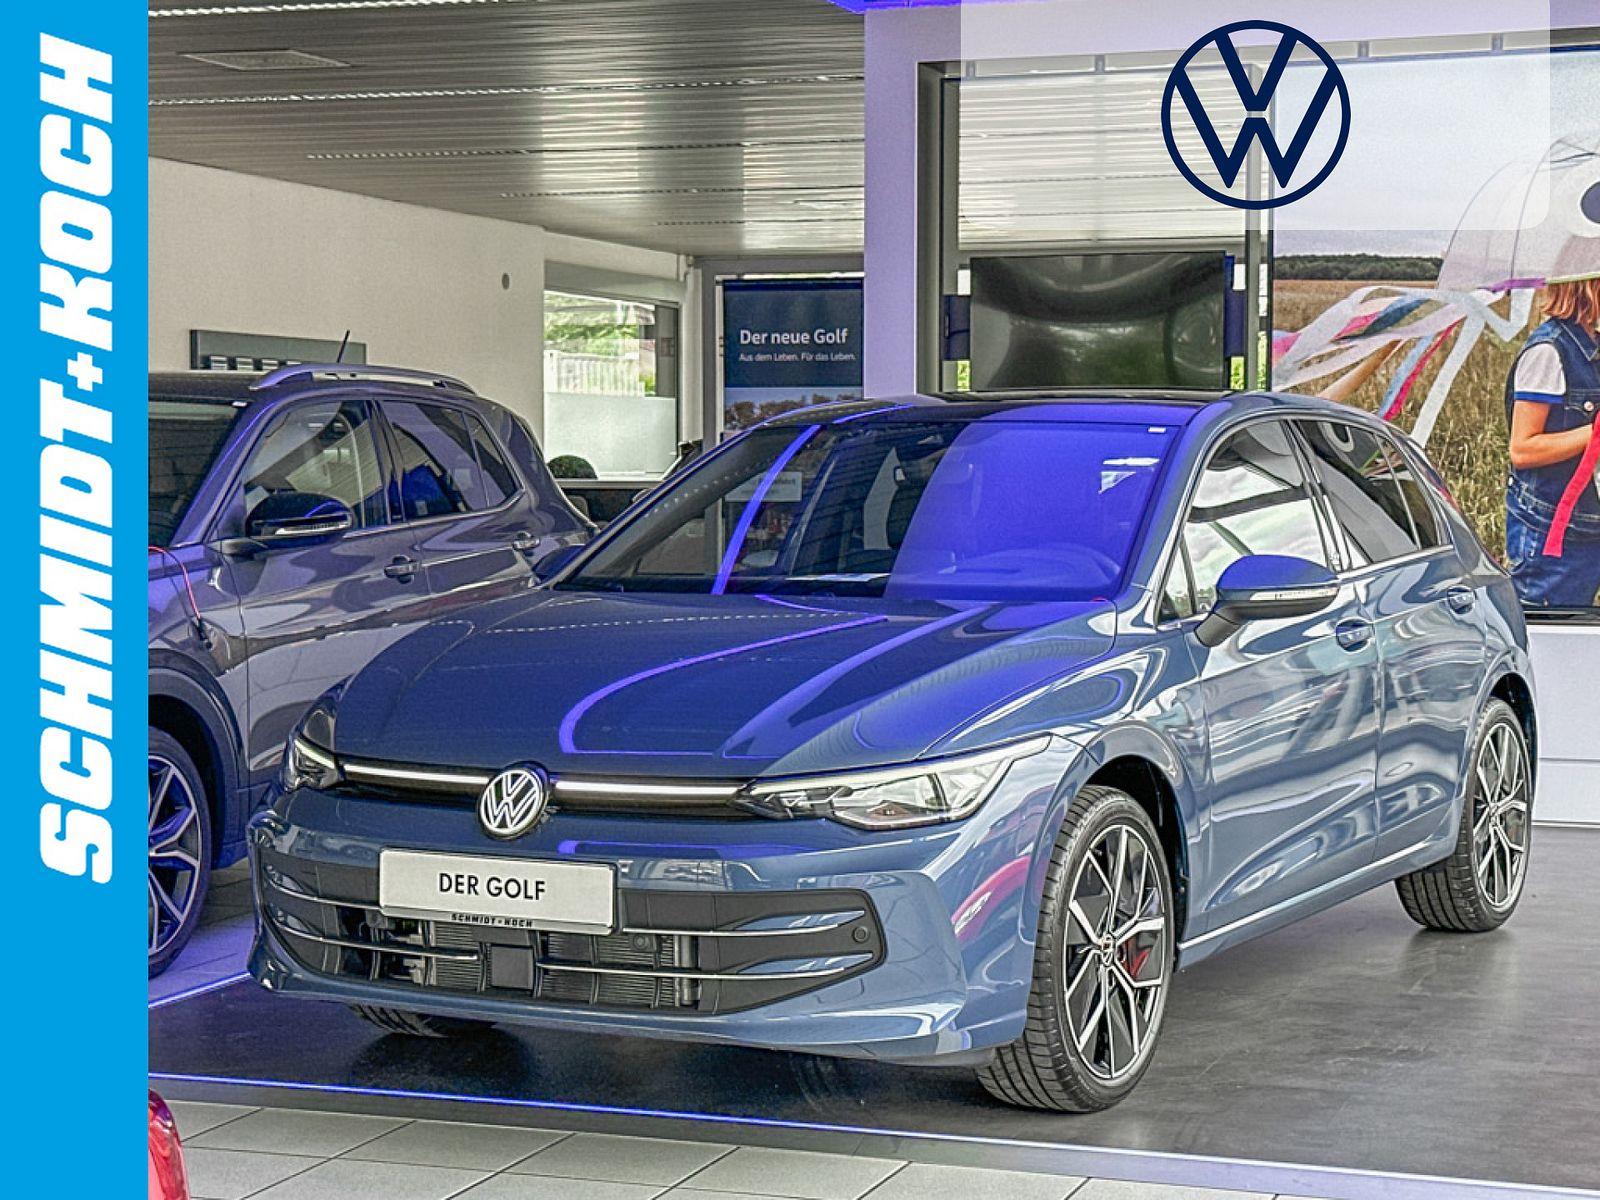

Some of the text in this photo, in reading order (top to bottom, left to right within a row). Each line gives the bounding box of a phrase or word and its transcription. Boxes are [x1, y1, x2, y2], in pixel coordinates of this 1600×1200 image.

[740, 328, 848, 345] Der neue Golf
[739, 353, 753, 361] Aus
[755, 353, 773, 361] dem
[801, 352, 813, 361] Für
[815, 352, 829, 361] das
[831, 353, 856, 361] Leben.
[439, 872, 546, 901] DER GOLF
